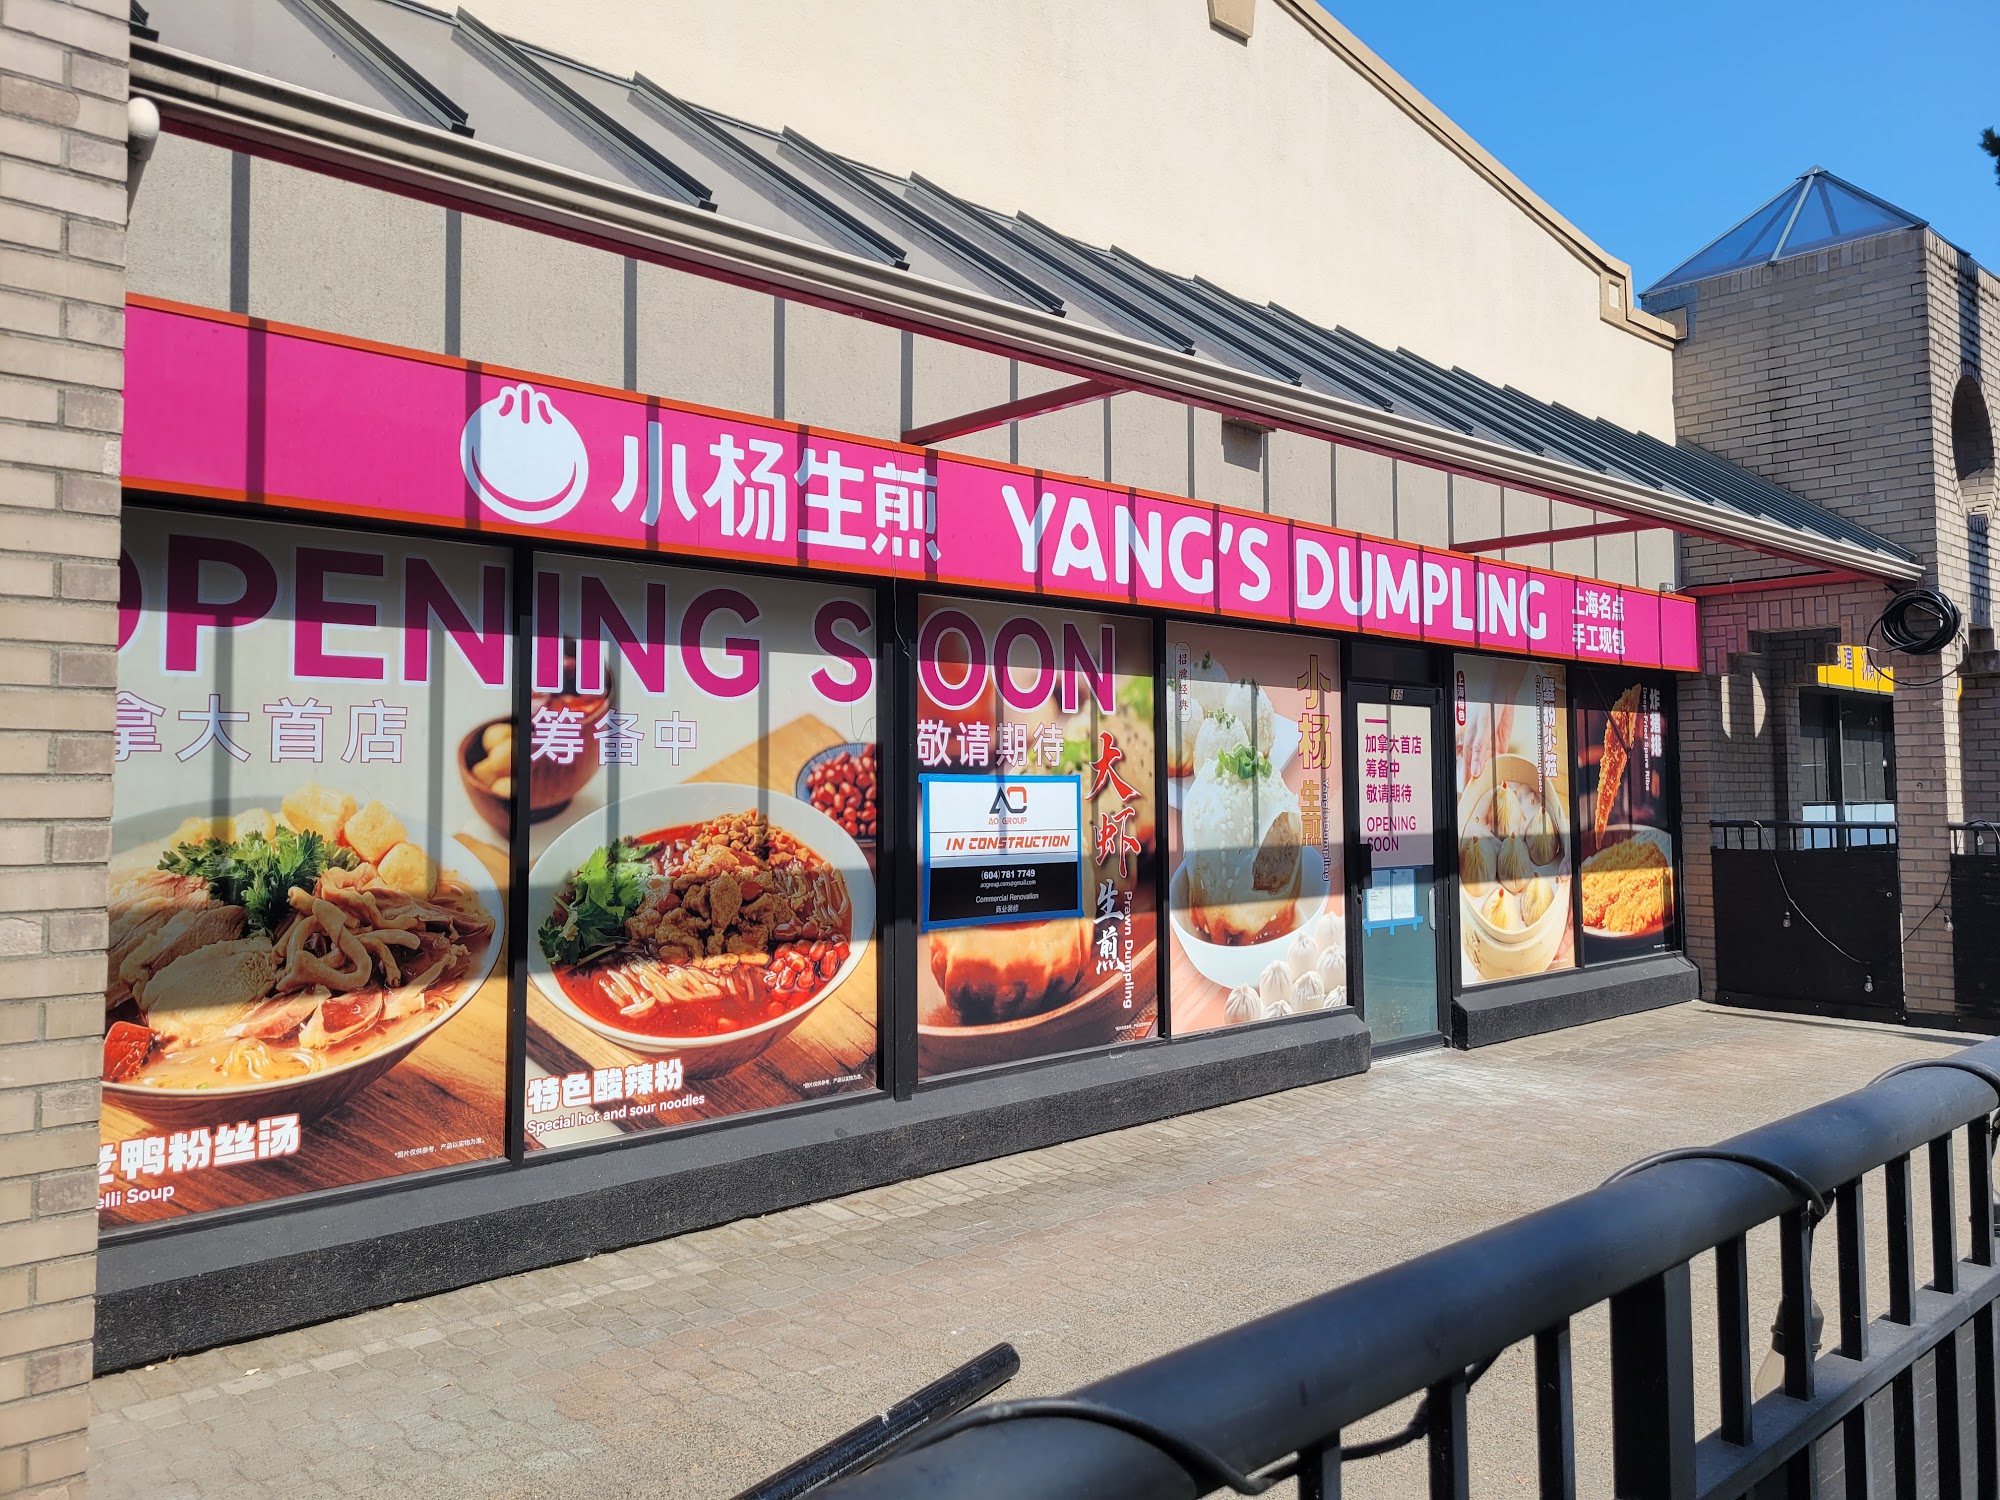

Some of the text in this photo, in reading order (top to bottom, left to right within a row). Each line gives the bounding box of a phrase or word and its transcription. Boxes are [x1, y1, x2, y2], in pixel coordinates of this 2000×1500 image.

[611, 420, 942, 562] 小杨生煎
[1001, 485, 1547, 640] YANG'S DUMPLING
[117, 533, 1116, 714] PENING SOON
[1570, 588, 1625, 622] 上海名点
[1571, 622, 1626, 656] 手工现包
[1177, 653, 1188, 711] 招牌经典
[530, 705, 698, 766] 筹备中
[917, 719, 1064, 768] 敬请期待
[1365, 733, 1422, 755] 加拿大首店
[1542, 677, 1558, 778] 蟹粉小笼
[1650, 687, 1662, 757] 炸猪排
[1296, 654, 1332, 847] 小杨生煎
[1365, 758, 1400, 779] 筹备中
[1365, 783, 1412, 804] 敬请期待
[945, 835, 1071, 851] IN CONSTRUCTION
[987, 817, 1028, 826] AO GROUP
[1366, 815, 1417, 833] OPENING
[1083, 730, 1142, 976] 大虾生煎
[1321, 822, 1332, 882] Dumpling
[1367, 836, 1399, 852] SOON
[981, 868, 1036, 880] (604) 781 7749
[976, 892, 1039, 904] Commercial Renovation
[1122, 891, 1134, 1009] Prawn Dumpling
[527, 1057, 684, 1114] 特色酸辣粉
[527, 1093, 706, 1137] Special hot and sour noodles
[126, 1185, 175, 1204] Soup
